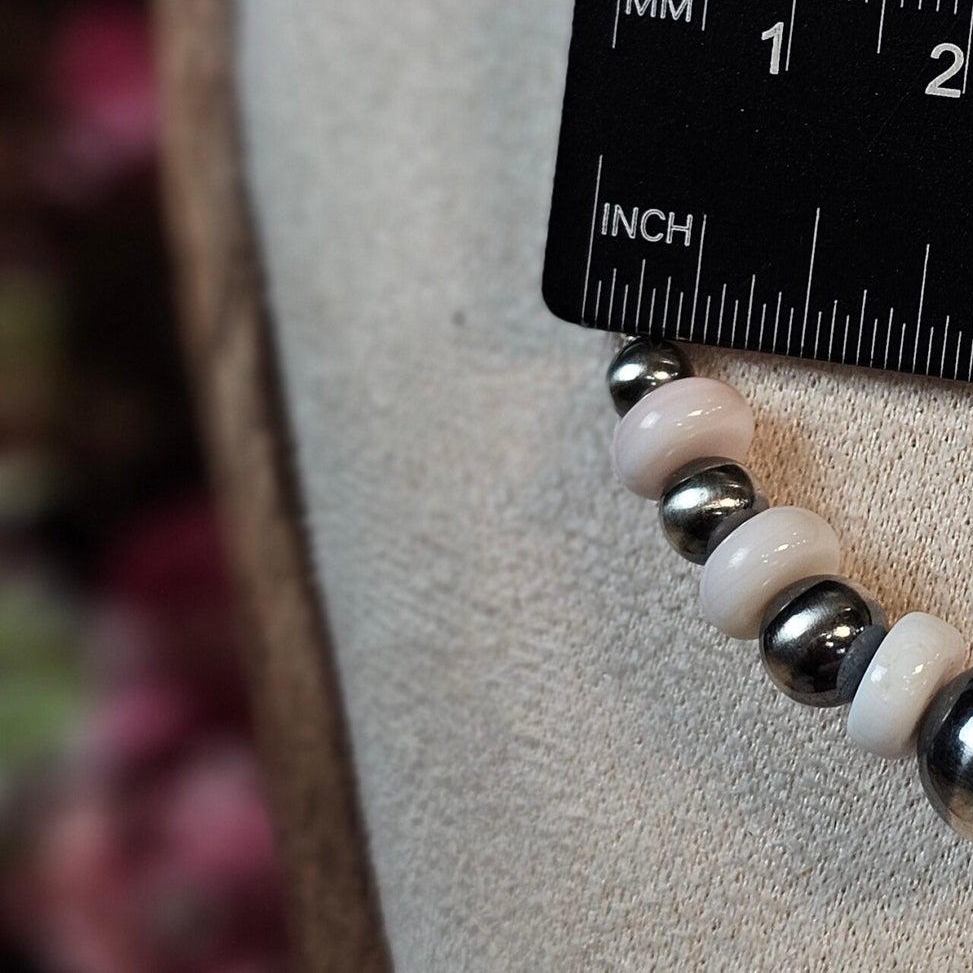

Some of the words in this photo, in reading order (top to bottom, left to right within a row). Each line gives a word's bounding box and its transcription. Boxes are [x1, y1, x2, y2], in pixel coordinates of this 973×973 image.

[760, 21, 785, 75] 1
[924, 42, 965, 99] 2
[600, 202, 694, 247] INCH
